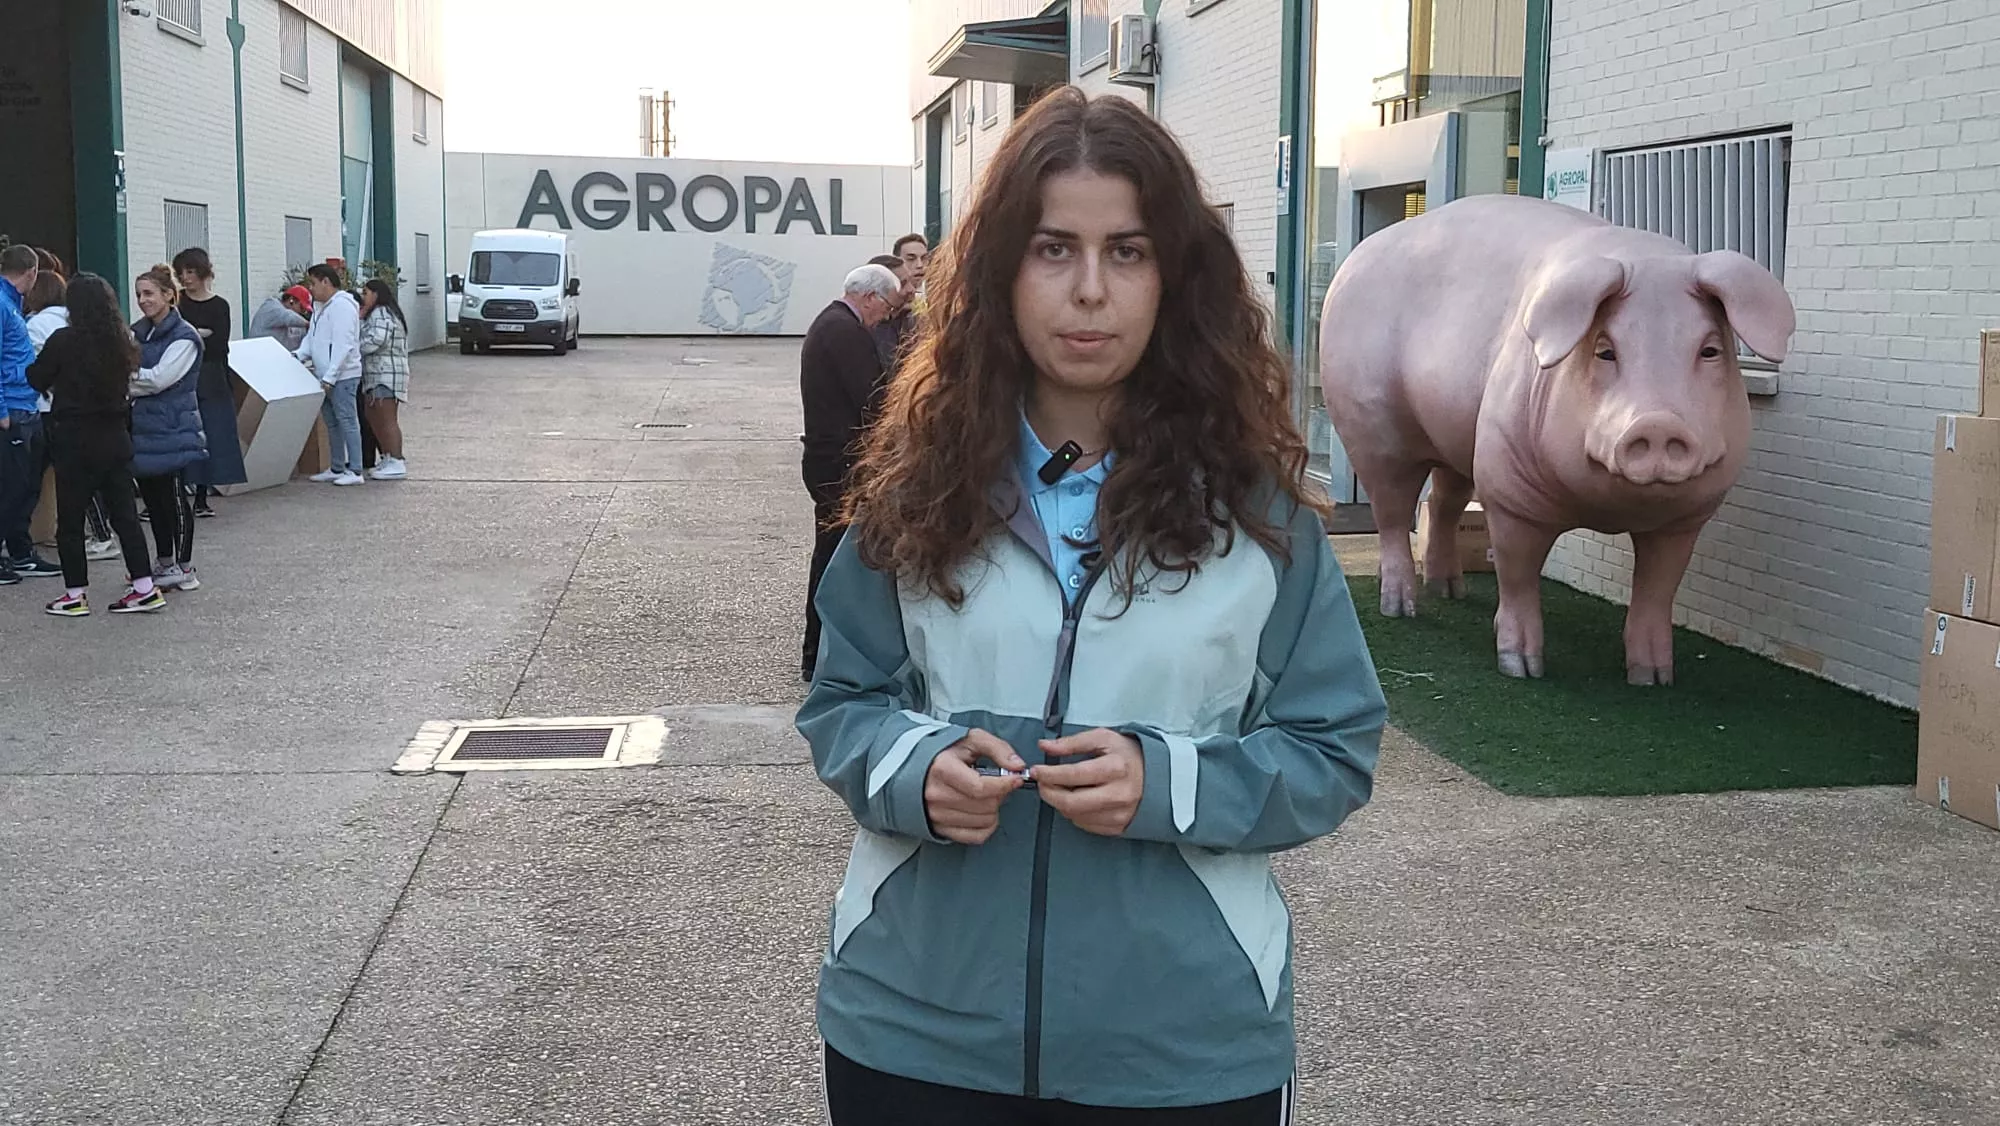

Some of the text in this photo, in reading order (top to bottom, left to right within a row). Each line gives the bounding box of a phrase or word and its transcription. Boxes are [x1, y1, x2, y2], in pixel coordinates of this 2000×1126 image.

[1559, 169, 1588, 185] AGROPAL
[516, 169, 858, 236] AGROPAL
[1938, 672, 1978, 713] ROPA
